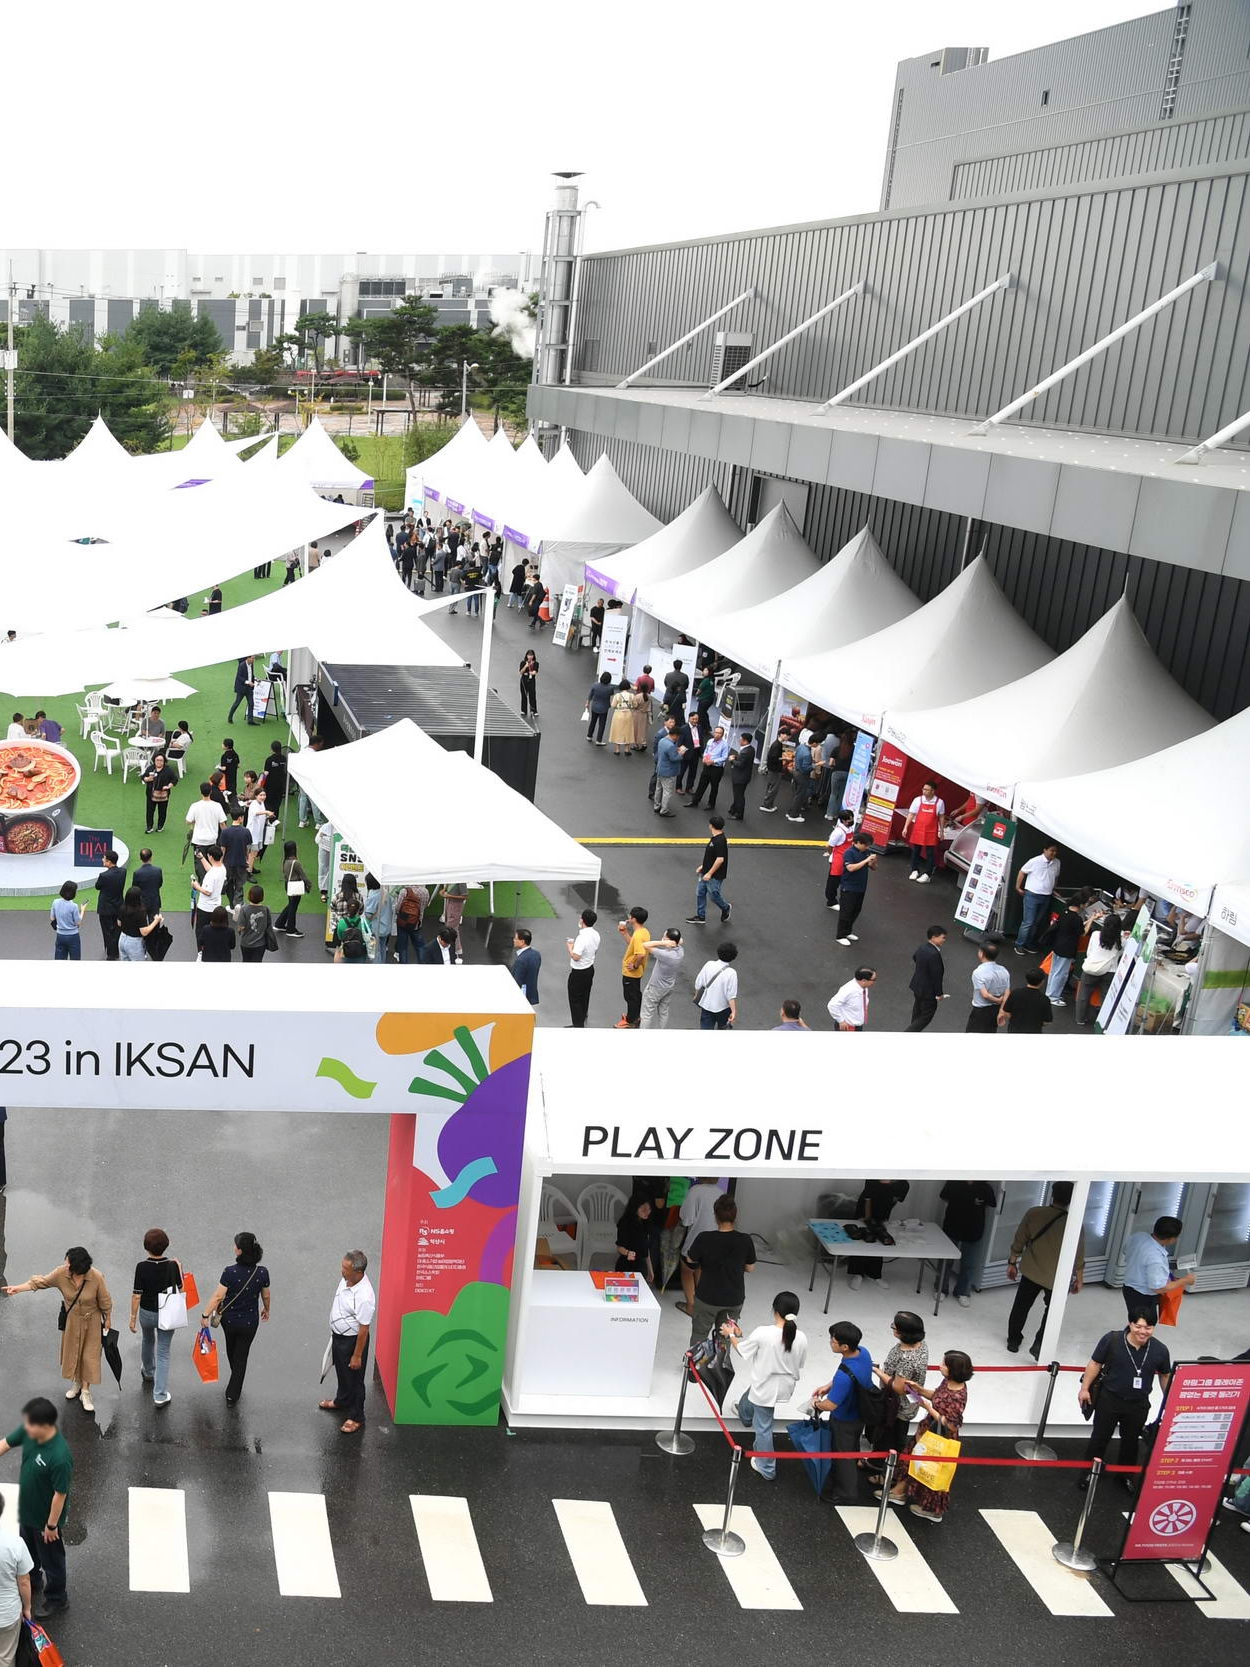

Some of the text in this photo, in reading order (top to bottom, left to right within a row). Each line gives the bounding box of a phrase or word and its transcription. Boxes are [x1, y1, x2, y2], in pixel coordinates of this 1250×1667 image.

[65, 1040, 100, 1076] in
[115, 1042, 255, 1078] IKSAN
[582, 1125, 823, 1161] PLAY ZONE
